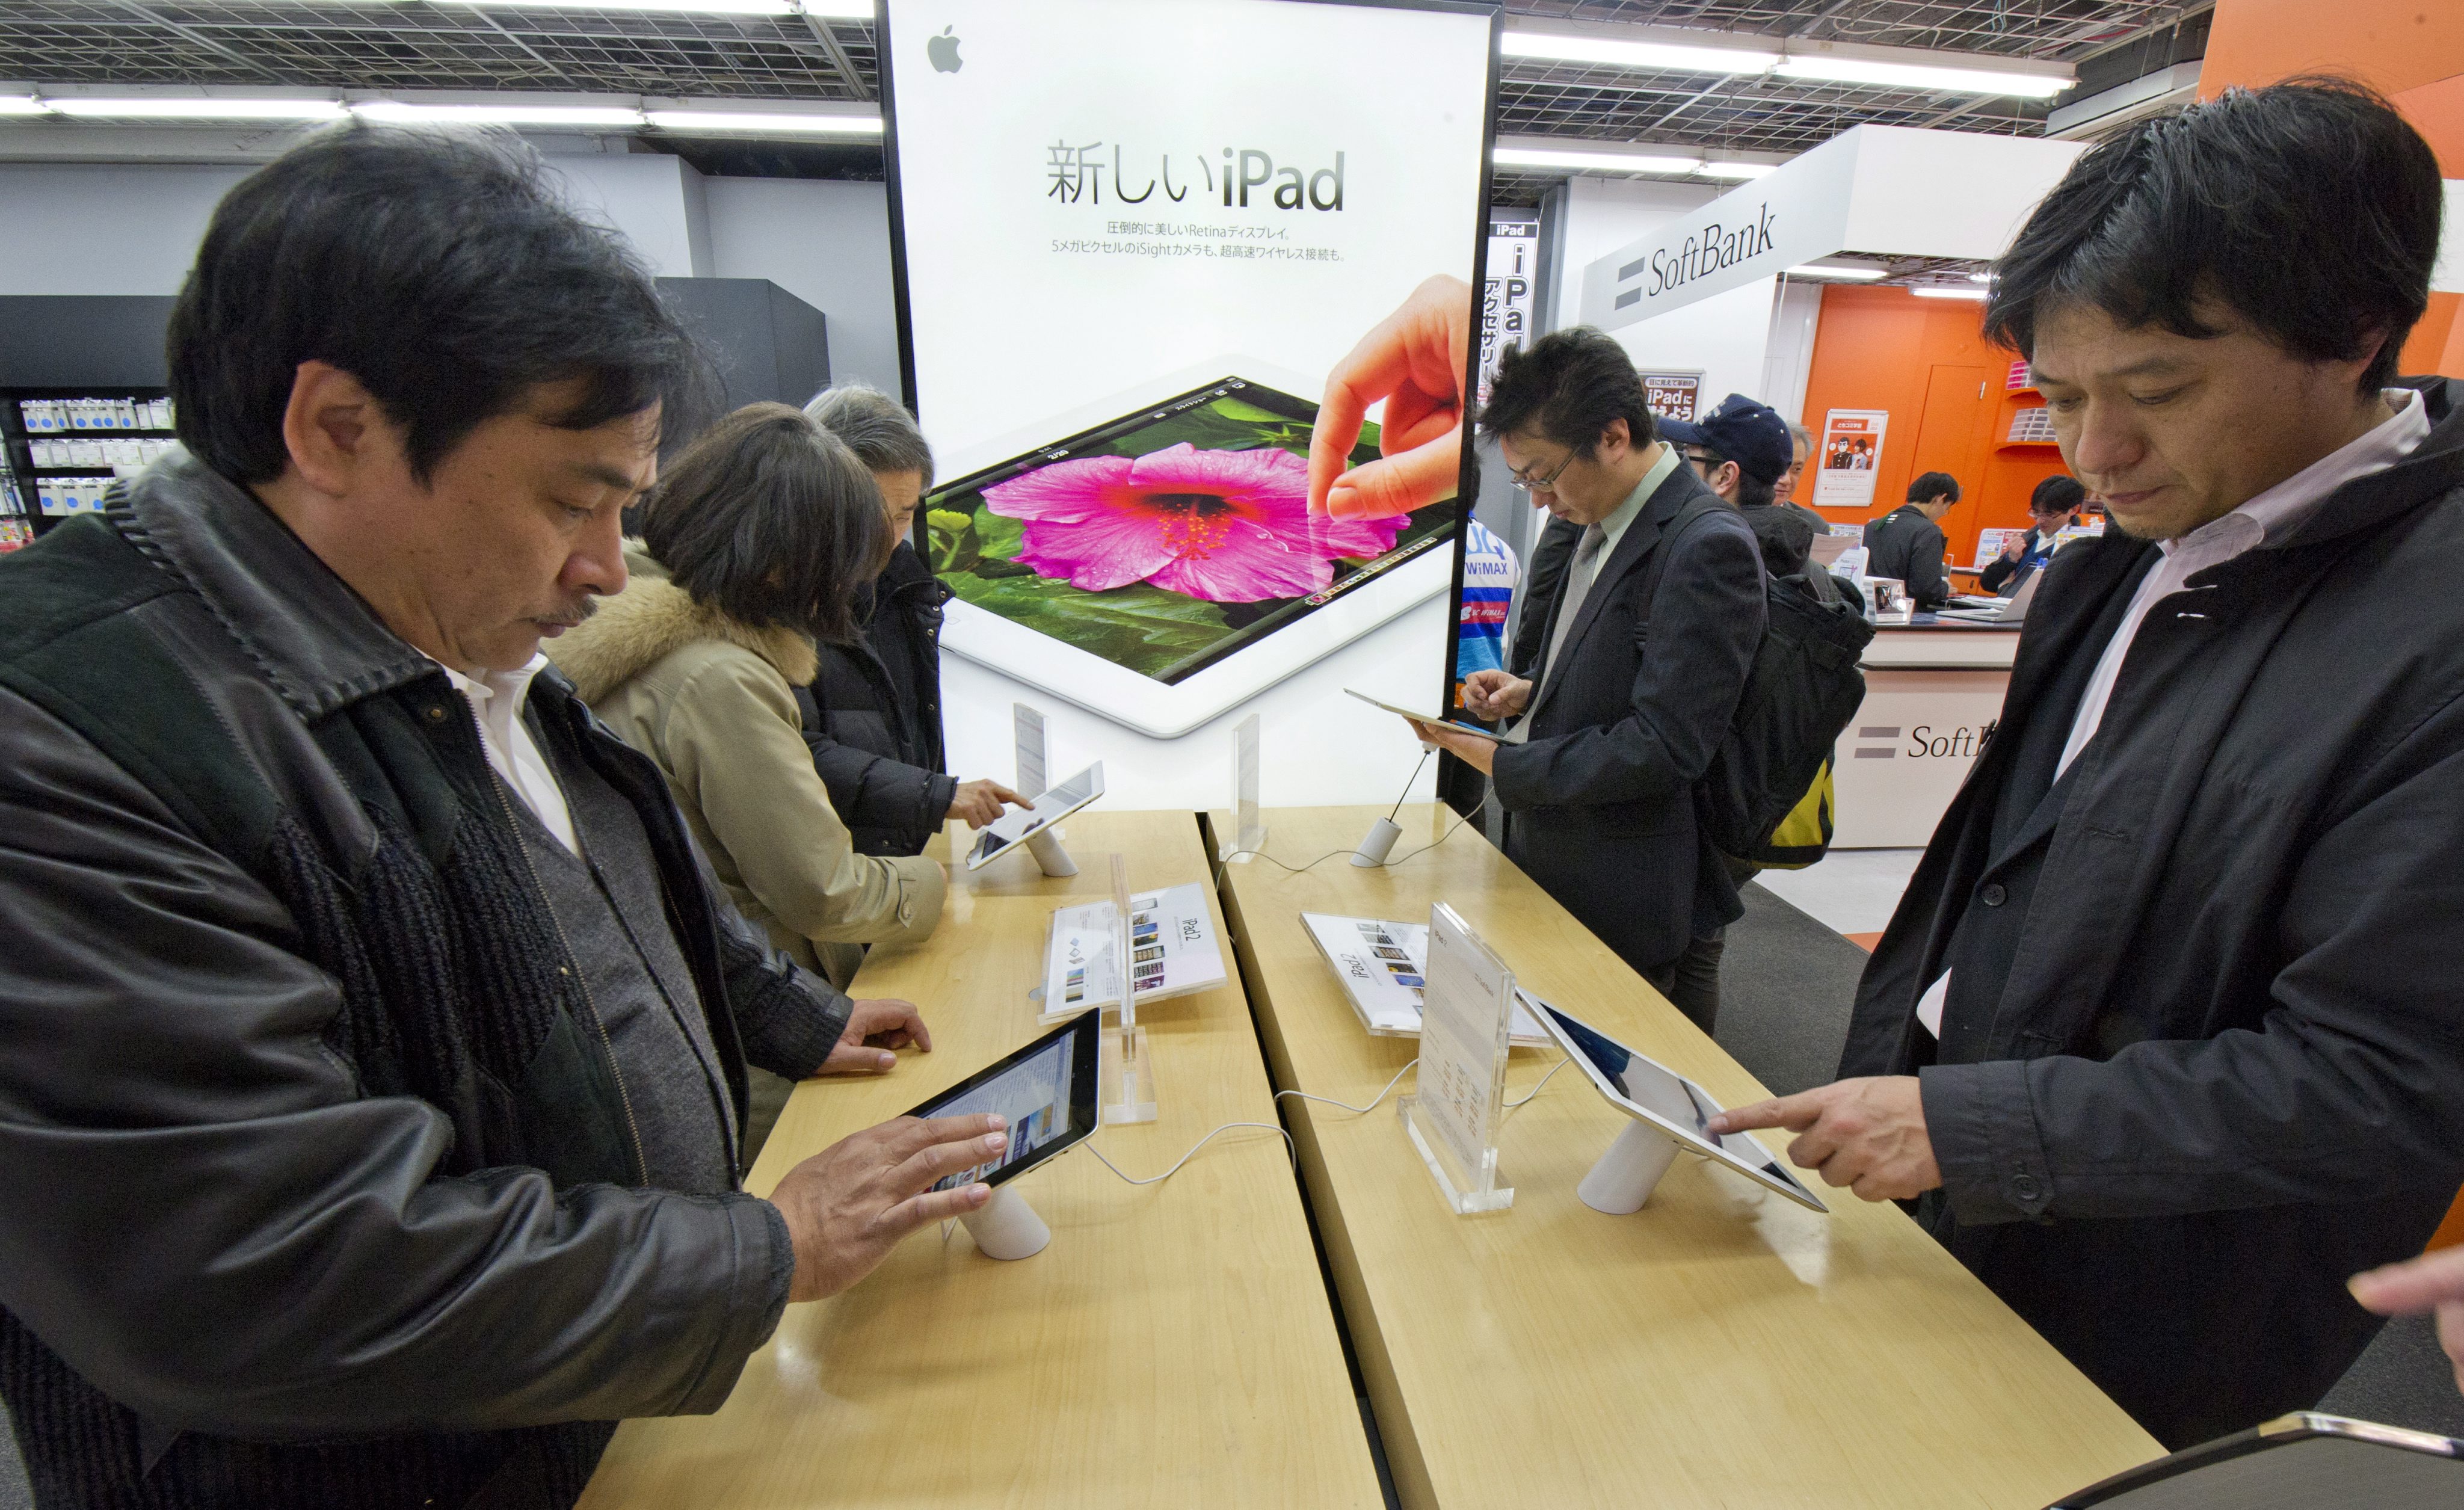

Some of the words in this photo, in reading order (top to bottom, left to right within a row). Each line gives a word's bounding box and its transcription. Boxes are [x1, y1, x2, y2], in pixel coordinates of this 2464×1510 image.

[1047, 139, 1345, 212] 新しいiPad
[1107, 221, 1289, 241] 圧倒的に美しいRetinaディスプレイ。
[1496, 224, 1525, 236] iPad
[1648, 201, 1776, 297] SoftBank
[1648, 389, 1693, 405] iPadに
[1465, 562, 1508, 575] WiMAX
[1182, 918, 1201, 935] iPad
[1343, 959, 1370, 978] iPad
